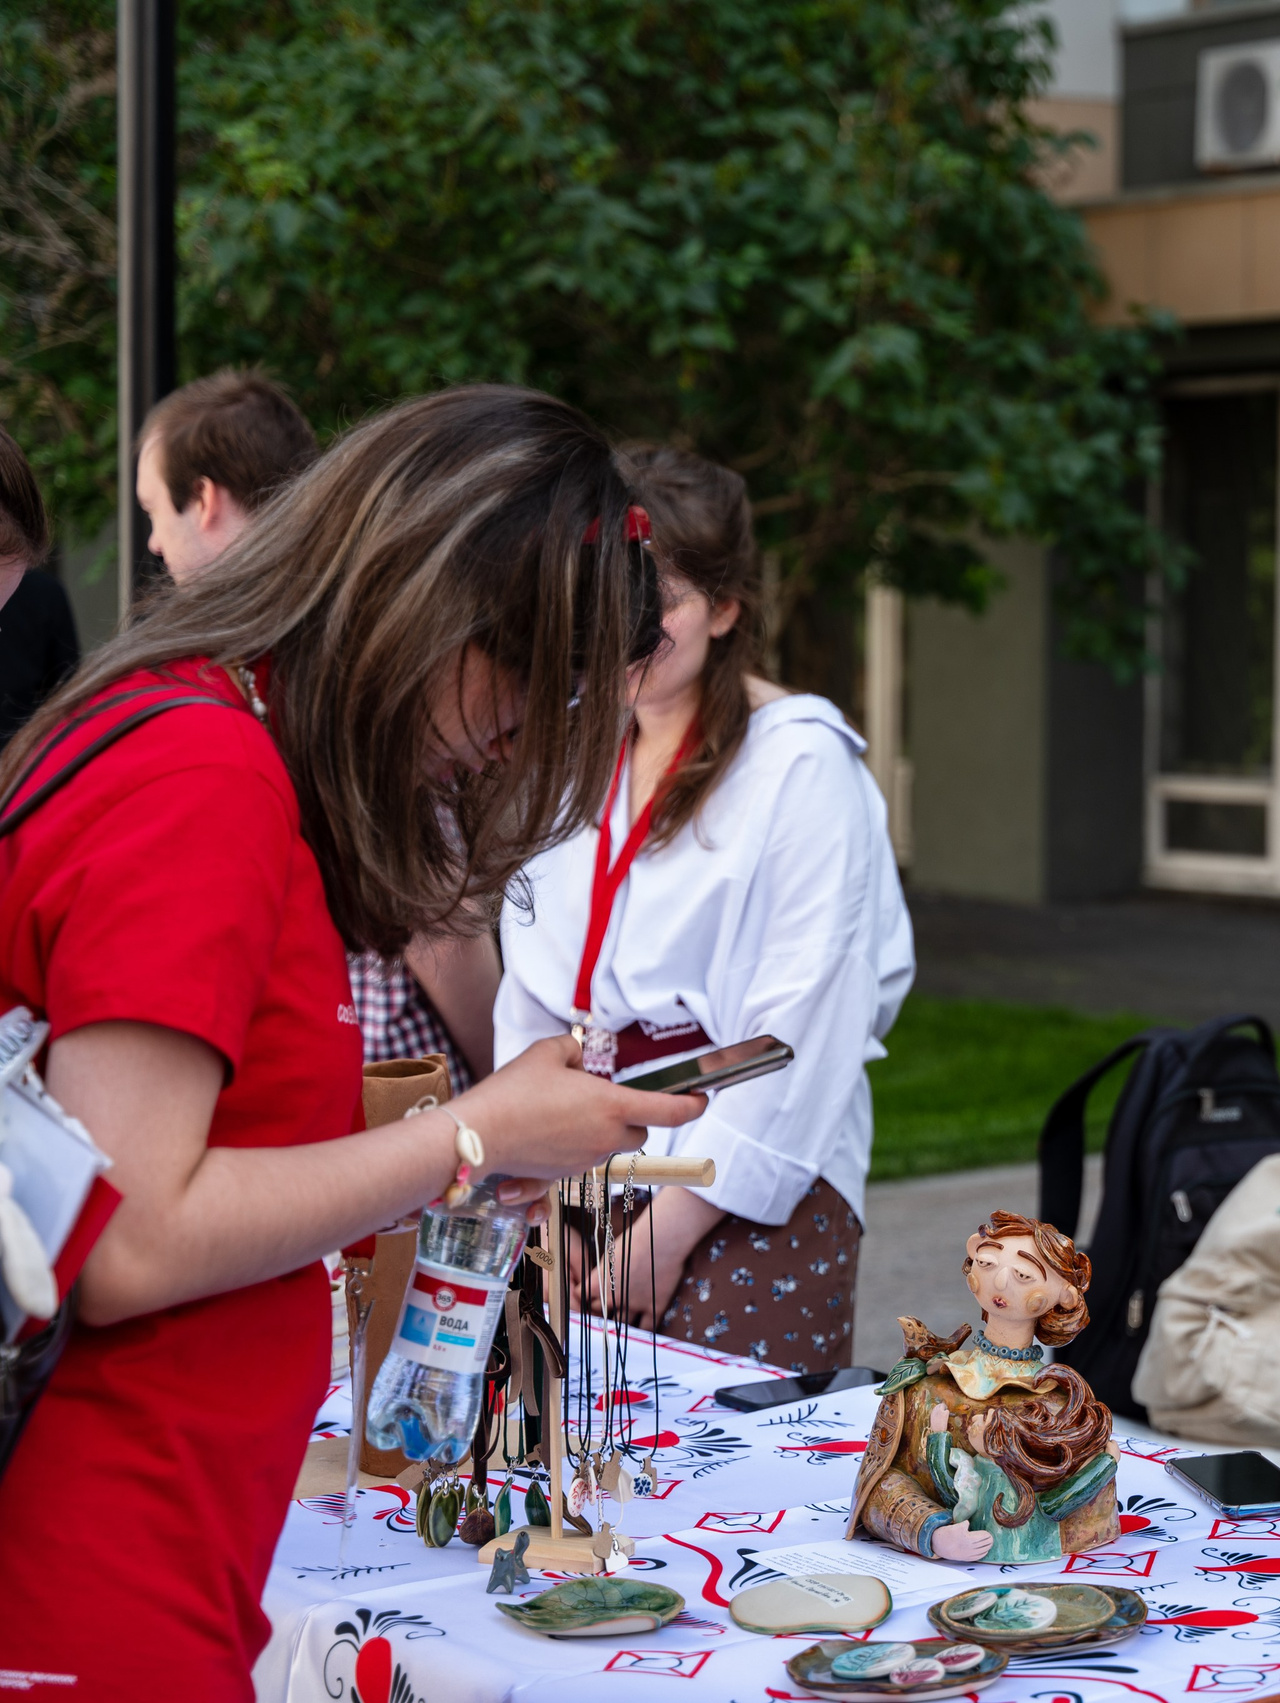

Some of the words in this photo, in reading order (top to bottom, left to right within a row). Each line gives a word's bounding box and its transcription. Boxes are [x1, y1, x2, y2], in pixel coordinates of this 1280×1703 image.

[535, 1251, 553, 1265] 1000
[436, 1293, 451, 1303] 365
[439, 1315, 468, 1331] ВОДА
